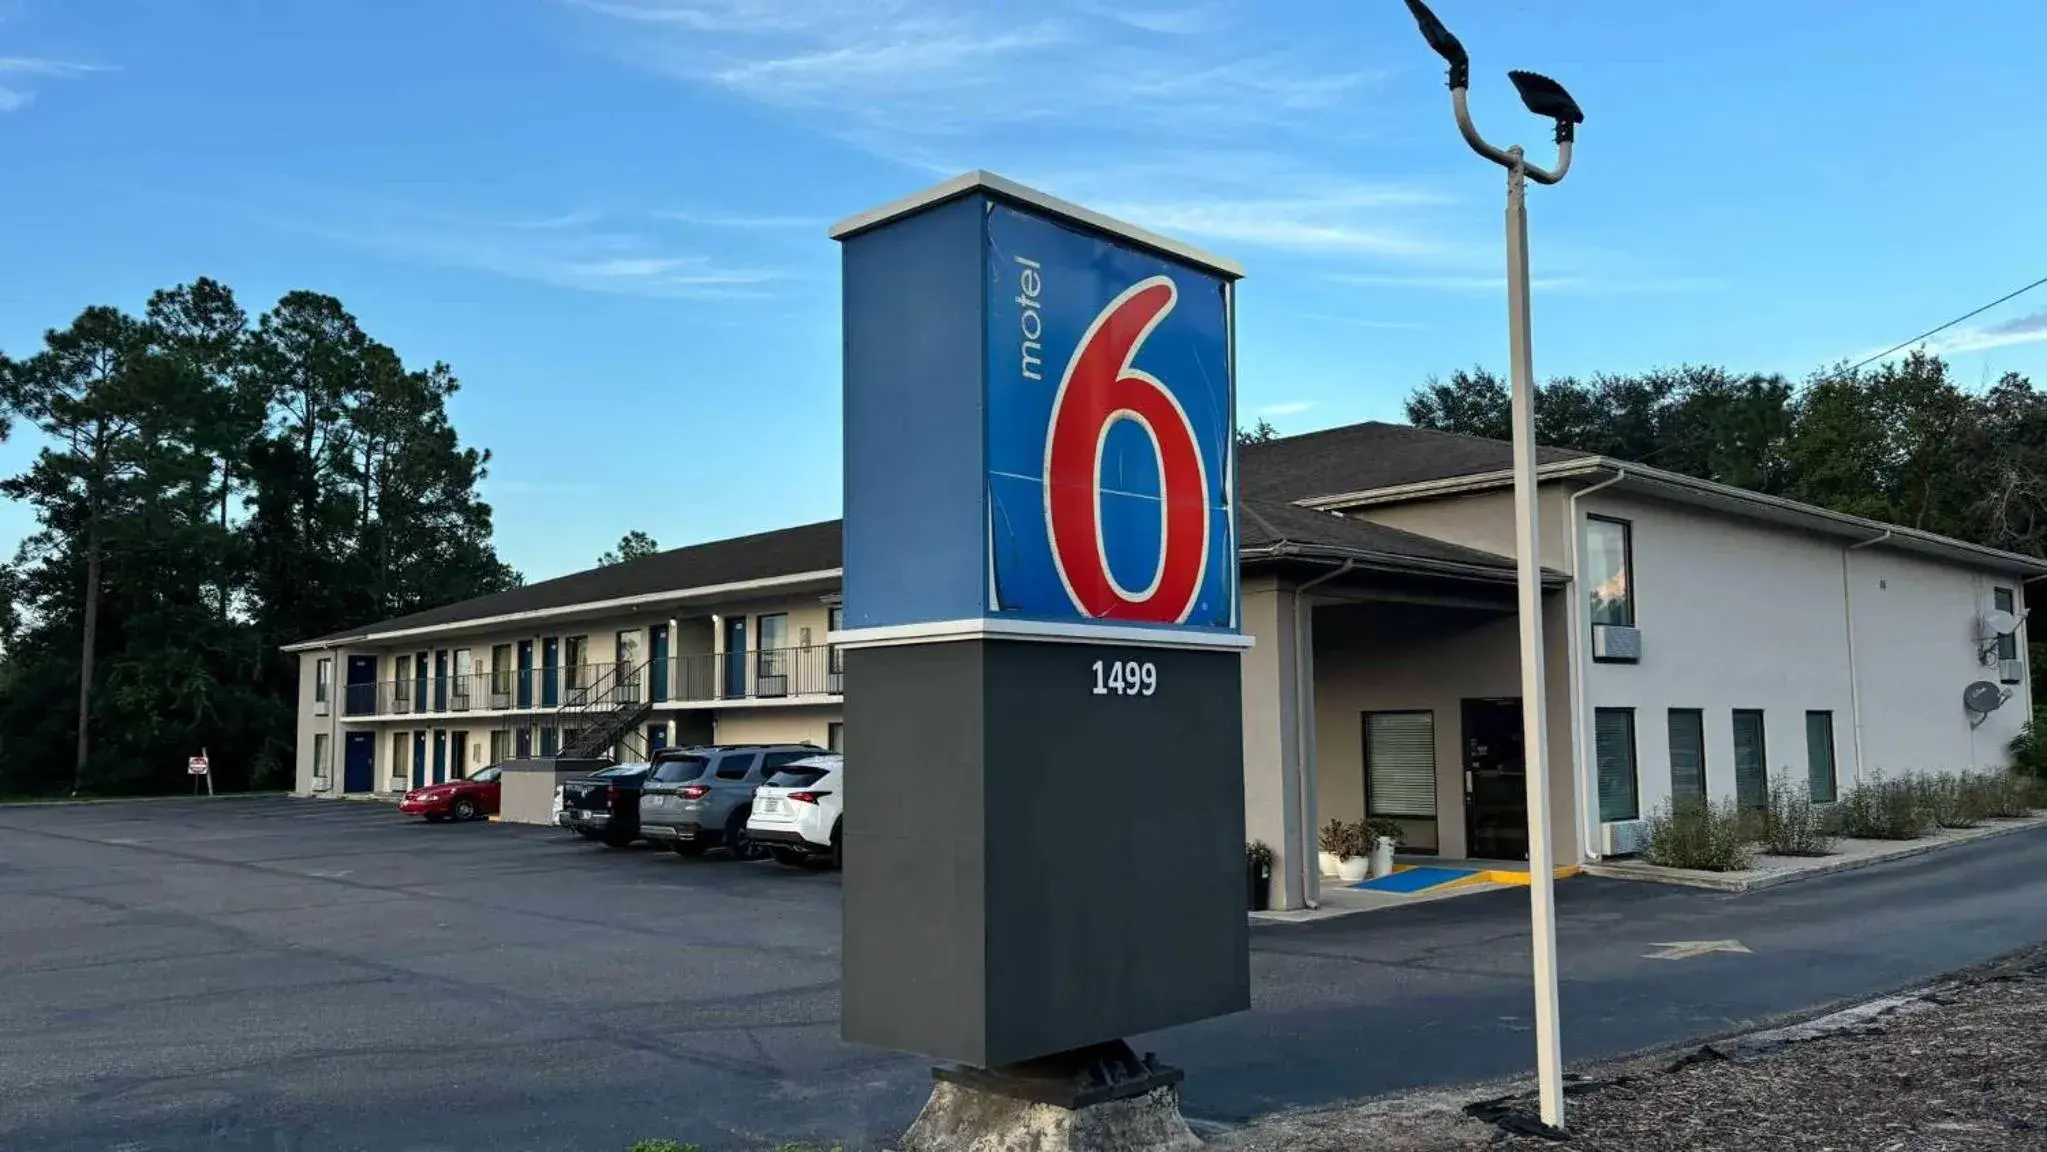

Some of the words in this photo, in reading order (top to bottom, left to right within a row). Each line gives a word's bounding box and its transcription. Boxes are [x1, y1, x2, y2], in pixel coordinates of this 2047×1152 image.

[1014, 254, 1042, 381] motel
[1043, 275, 1210, 624] 6
[1092, 660, 1157, 696] 1499
